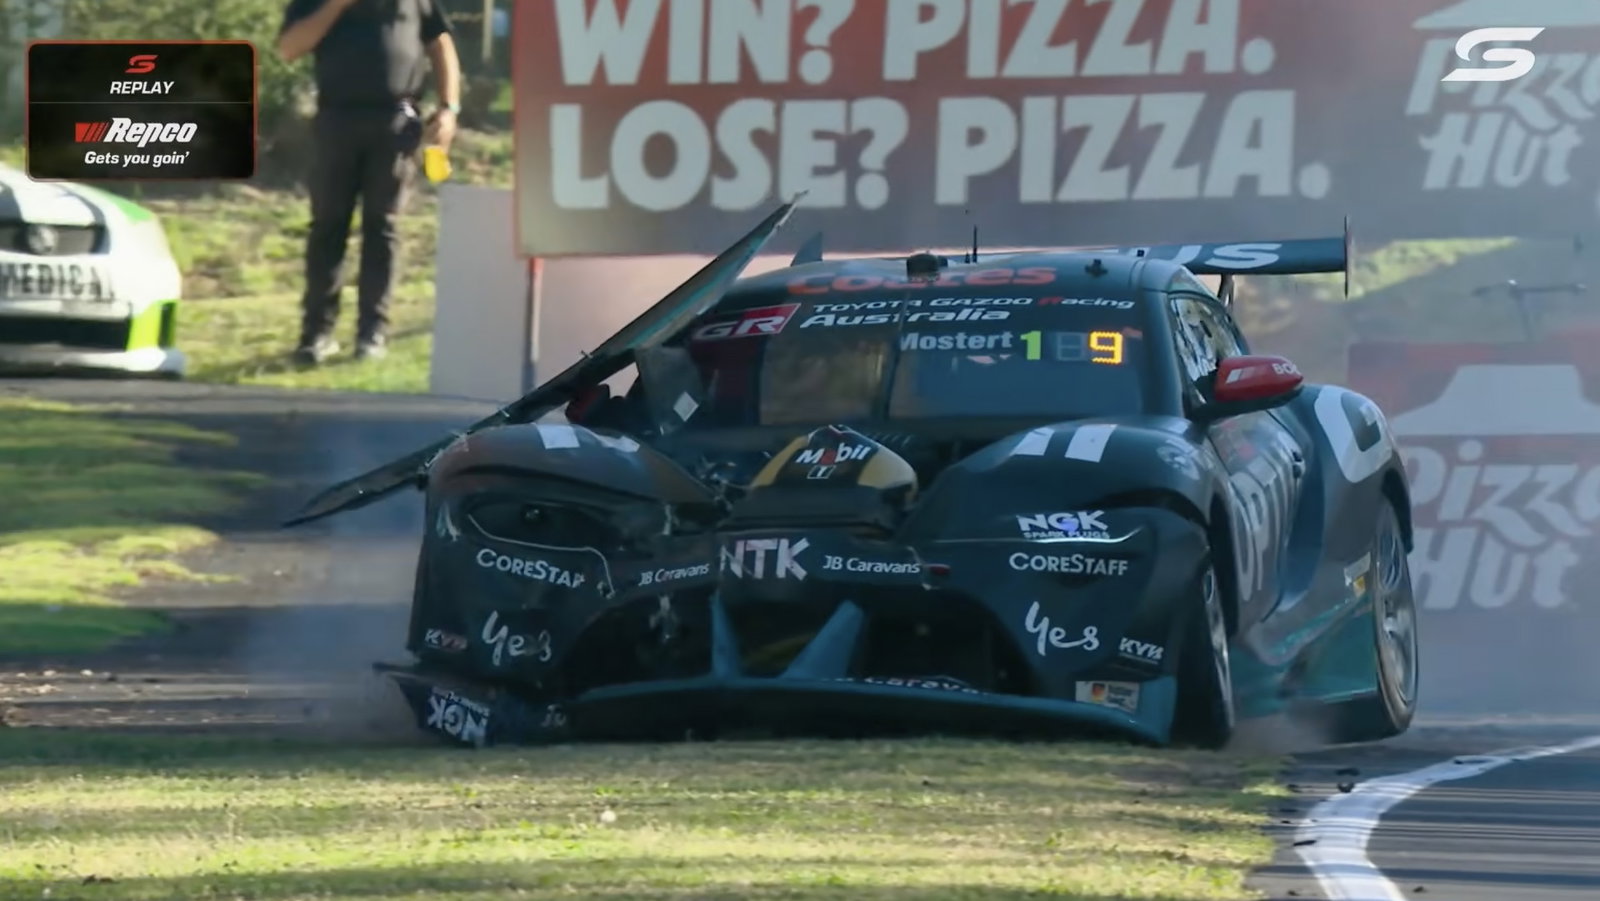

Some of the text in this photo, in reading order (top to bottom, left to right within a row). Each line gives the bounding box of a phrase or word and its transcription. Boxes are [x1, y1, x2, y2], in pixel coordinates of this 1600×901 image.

[554, 0, 1276, 85] WIN? PIZZA.
[550, 89, 1331, 211] LOSE? PIZZA.
[813, 299, 922, 312] TOYOTA
[929, 298, 1033, 307] GAZOO
[693, 316, 786, 338] GR
[800, 308, 1011, 328] Australia
[900, 330, 1042, 360] Mostert 1
[1089, 331, 1123, 364] 9
[795, 442, 872, 464] Mobil
[1016, 509, 1109, 531] NGK
[720, 537, 811, 581] NTK
[822, 555, 921, 574] JB Caravans
